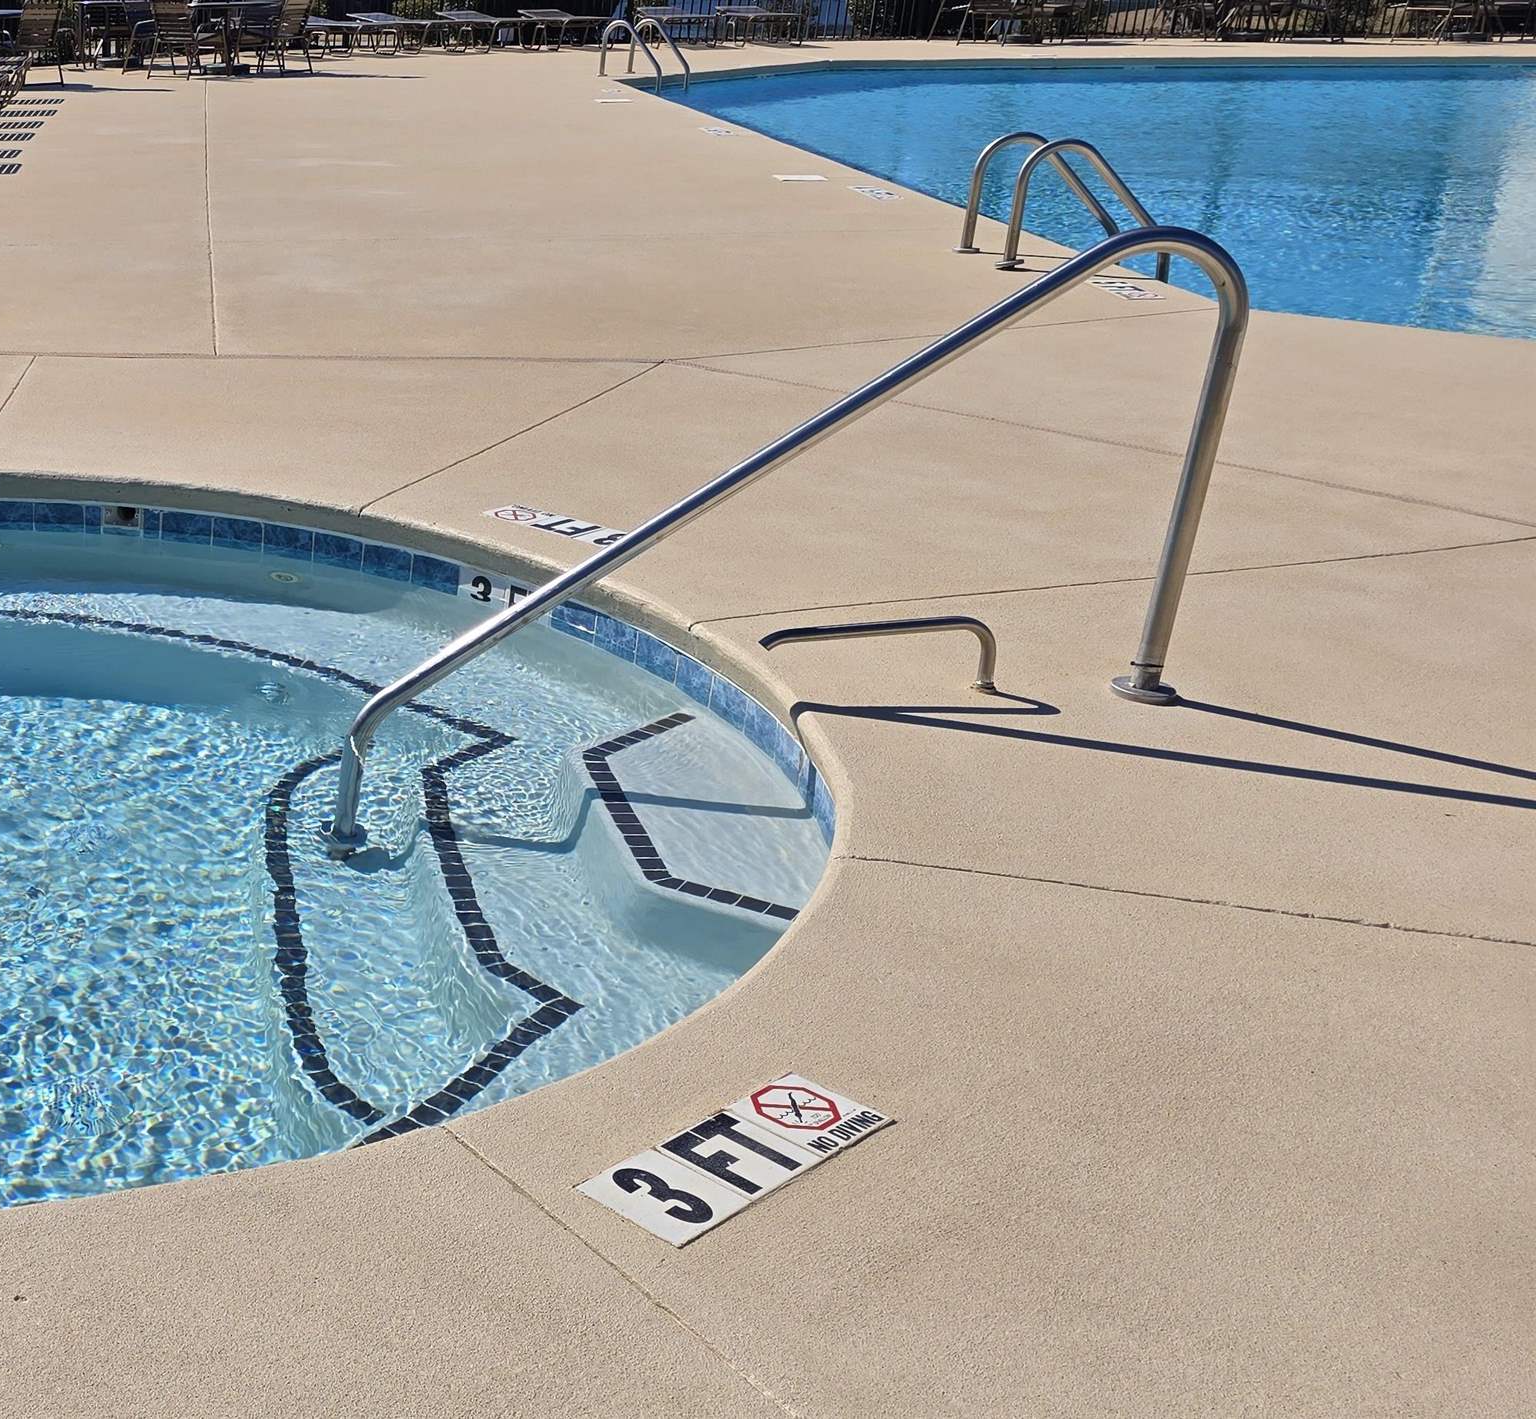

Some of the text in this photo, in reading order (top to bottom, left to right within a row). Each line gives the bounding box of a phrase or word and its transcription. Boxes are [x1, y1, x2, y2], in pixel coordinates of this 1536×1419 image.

[530, 518, 602, 536] FT
[470, 575, 492, 602] 3
[806, 1136, 840, 1153] NO
[828, 1110, 886, 1141] DIVING
[612, 1111, 803, 1224] 3 FT
